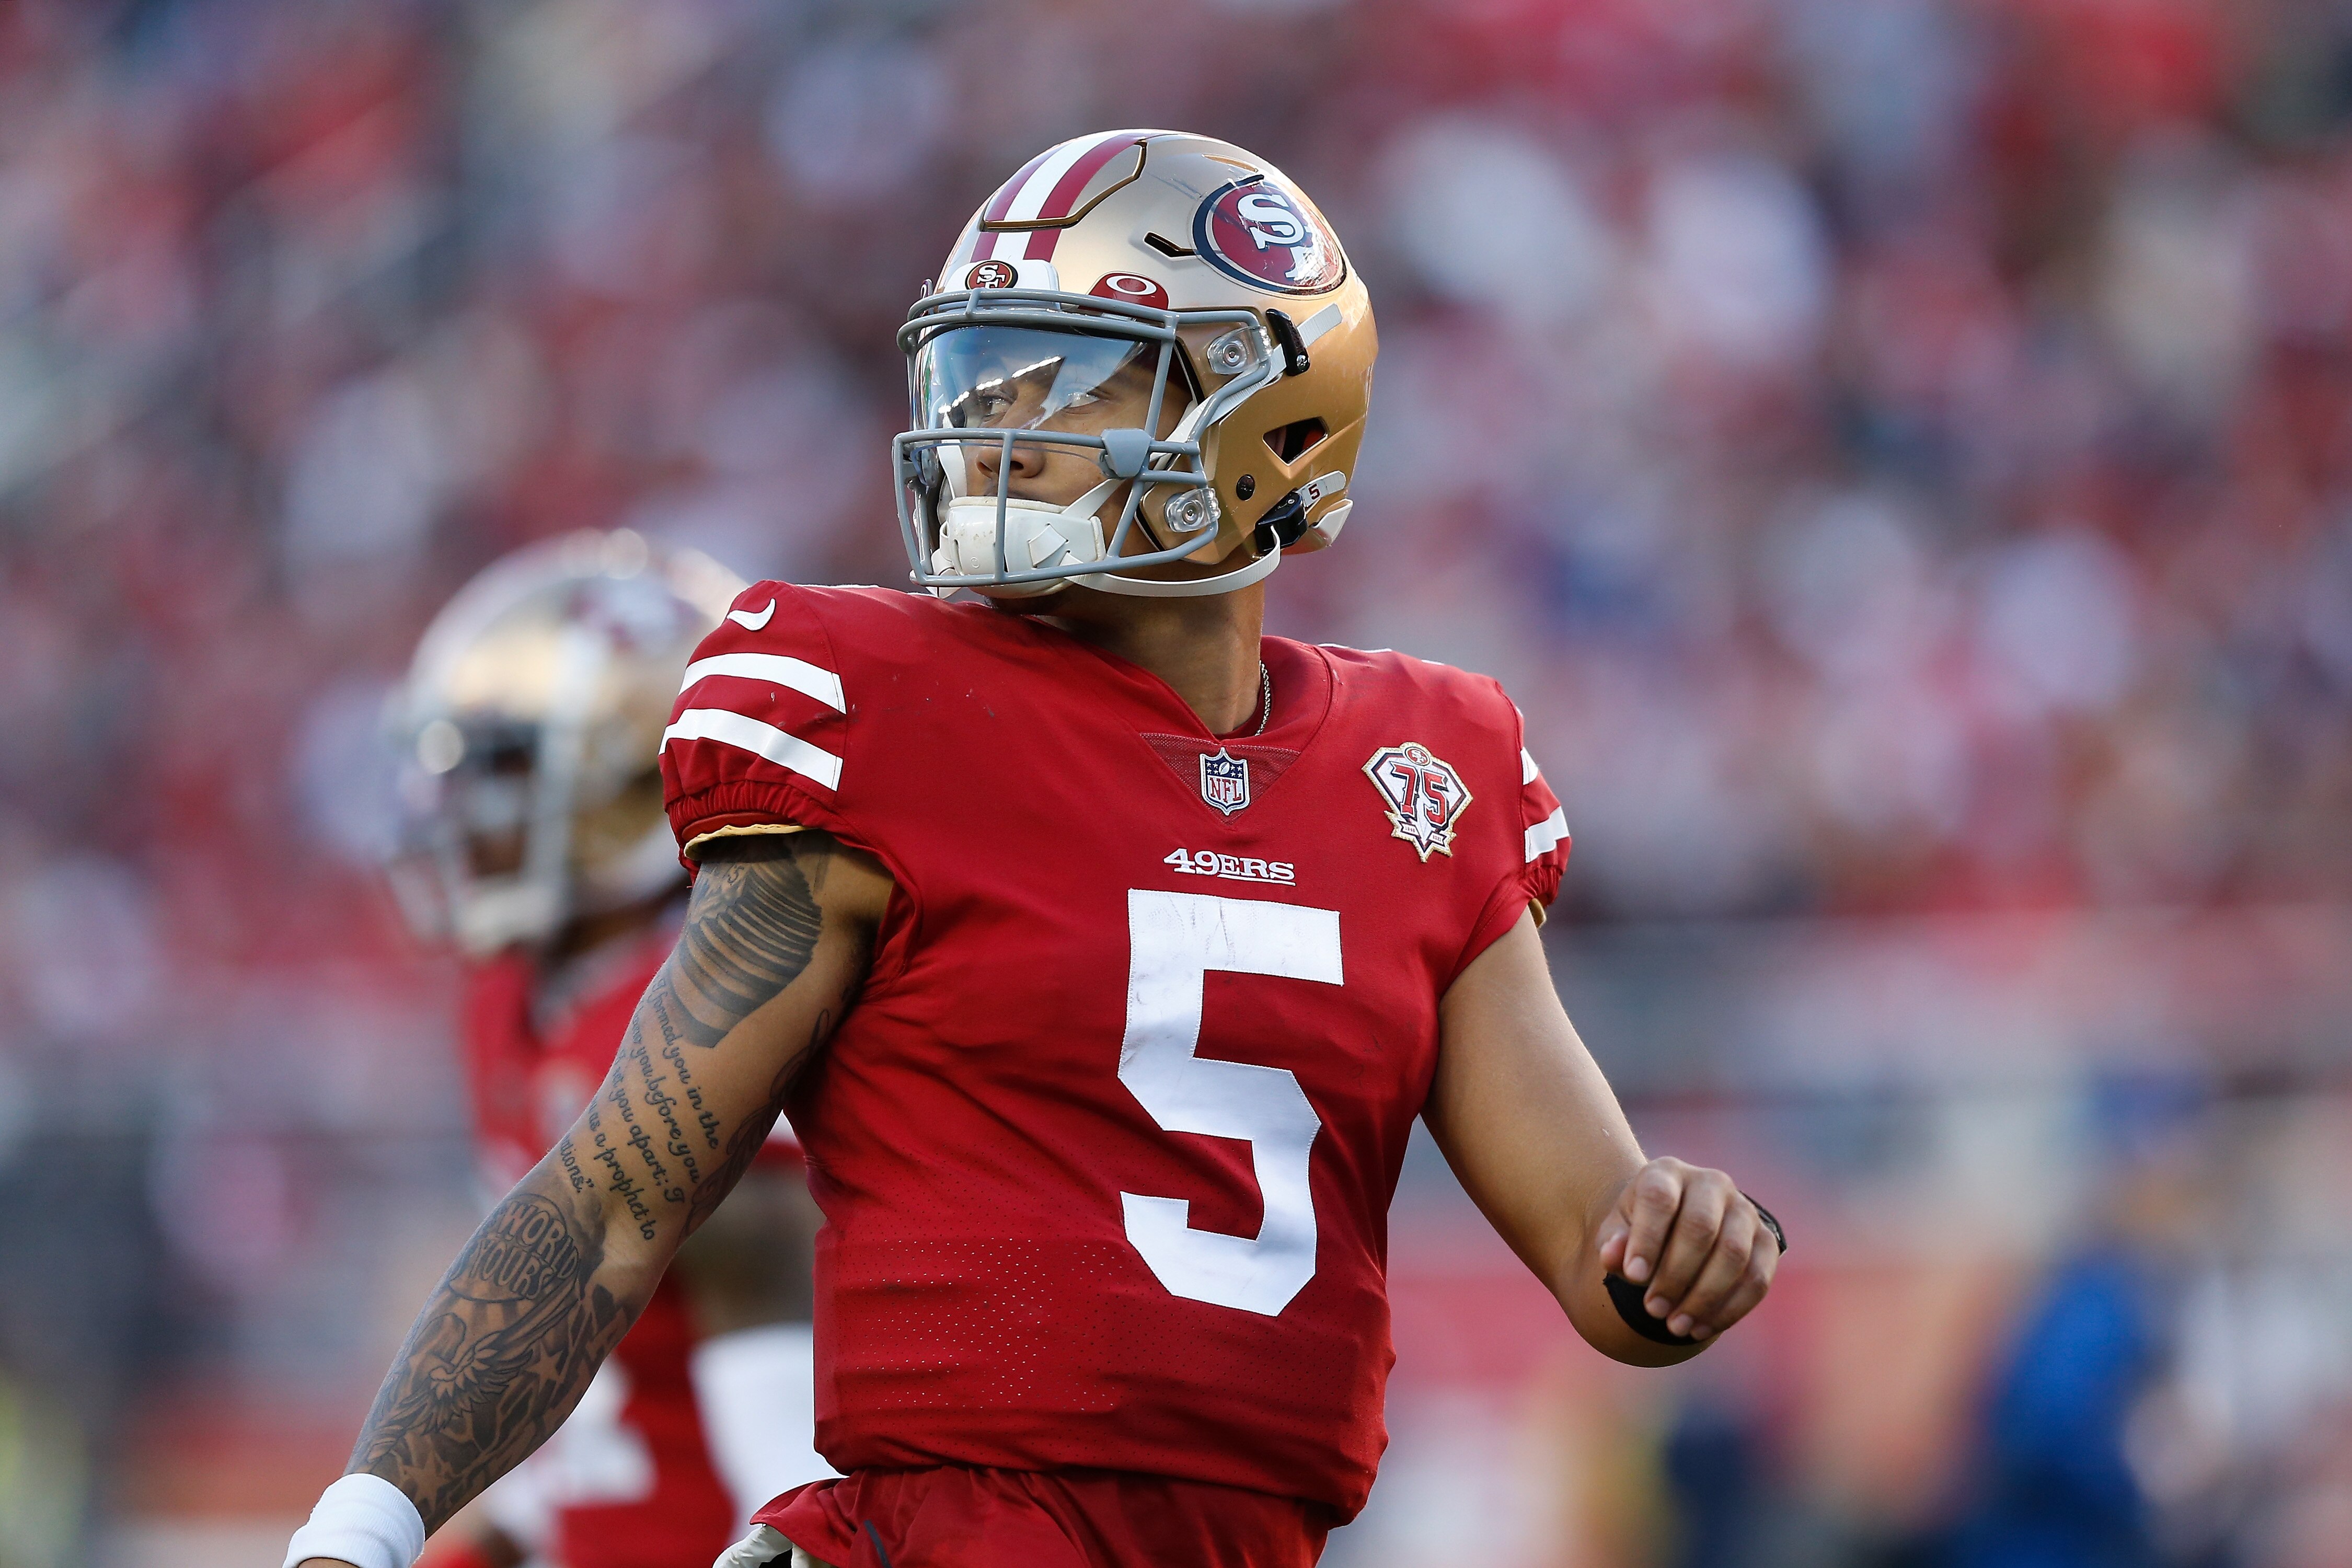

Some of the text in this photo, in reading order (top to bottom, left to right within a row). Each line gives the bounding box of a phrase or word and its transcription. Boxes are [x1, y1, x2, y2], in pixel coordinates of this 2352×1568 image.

[1308, 483, 1320, 500] 5
[1210, 777, 1242, 803] NFL
[1389, 761, 1449, 828] 75
[1163, 848, 1296, 882] 49ERS
[648, 991, 683, 1046] formed
[663, 1046, 690, 1084] you
[608, 1088, 633, 1122] you
[687, 1086, 702, 1110] in
[1117, 888, 1344, 1317] 5
[589, 1112, 600, 1132] as
[595, 1133, 606, 1147] a
[645, 1076, 682, 1139] before
[668, 1140, 700, 1184] you
[699, 1111, 720, 1149] the
[594, 1148, 649, 1220] prophet
[498, 1202, 579, 1279] WORLD
[640, 1220, 656, 1240] to
[469, 1238, 555, 1300] YOURS
